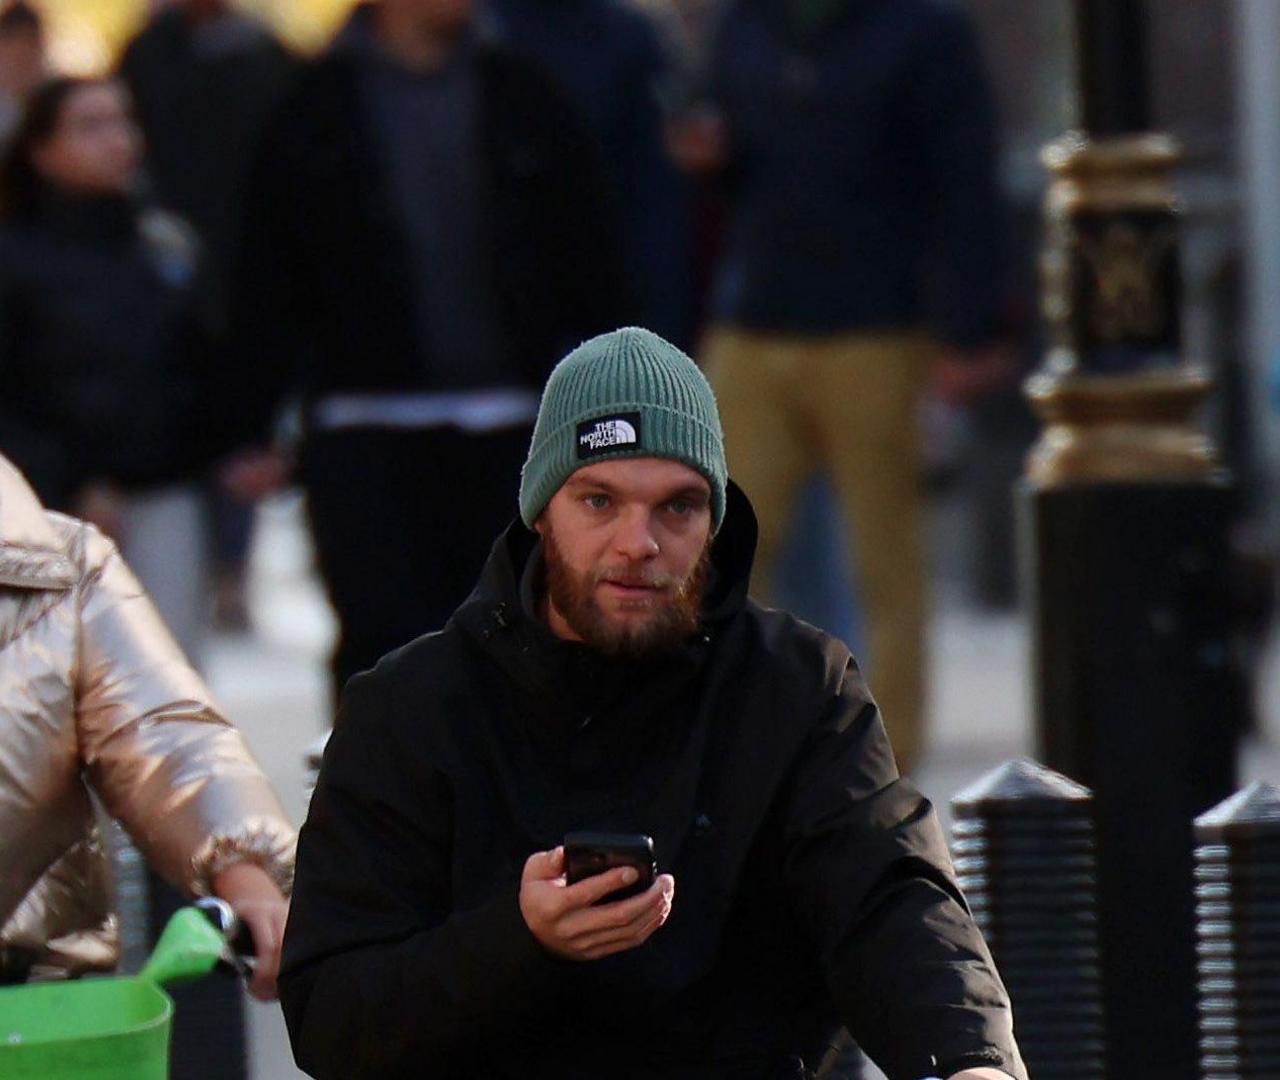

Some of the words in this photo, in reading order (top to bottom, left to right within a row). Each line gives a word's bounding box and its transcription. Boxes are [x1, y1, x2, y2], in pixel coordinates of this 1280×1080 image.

[595, 420, 615, 432] THE
[580, 429, 616, 445] NORTH
[590, 437, 616, 451] FACE
